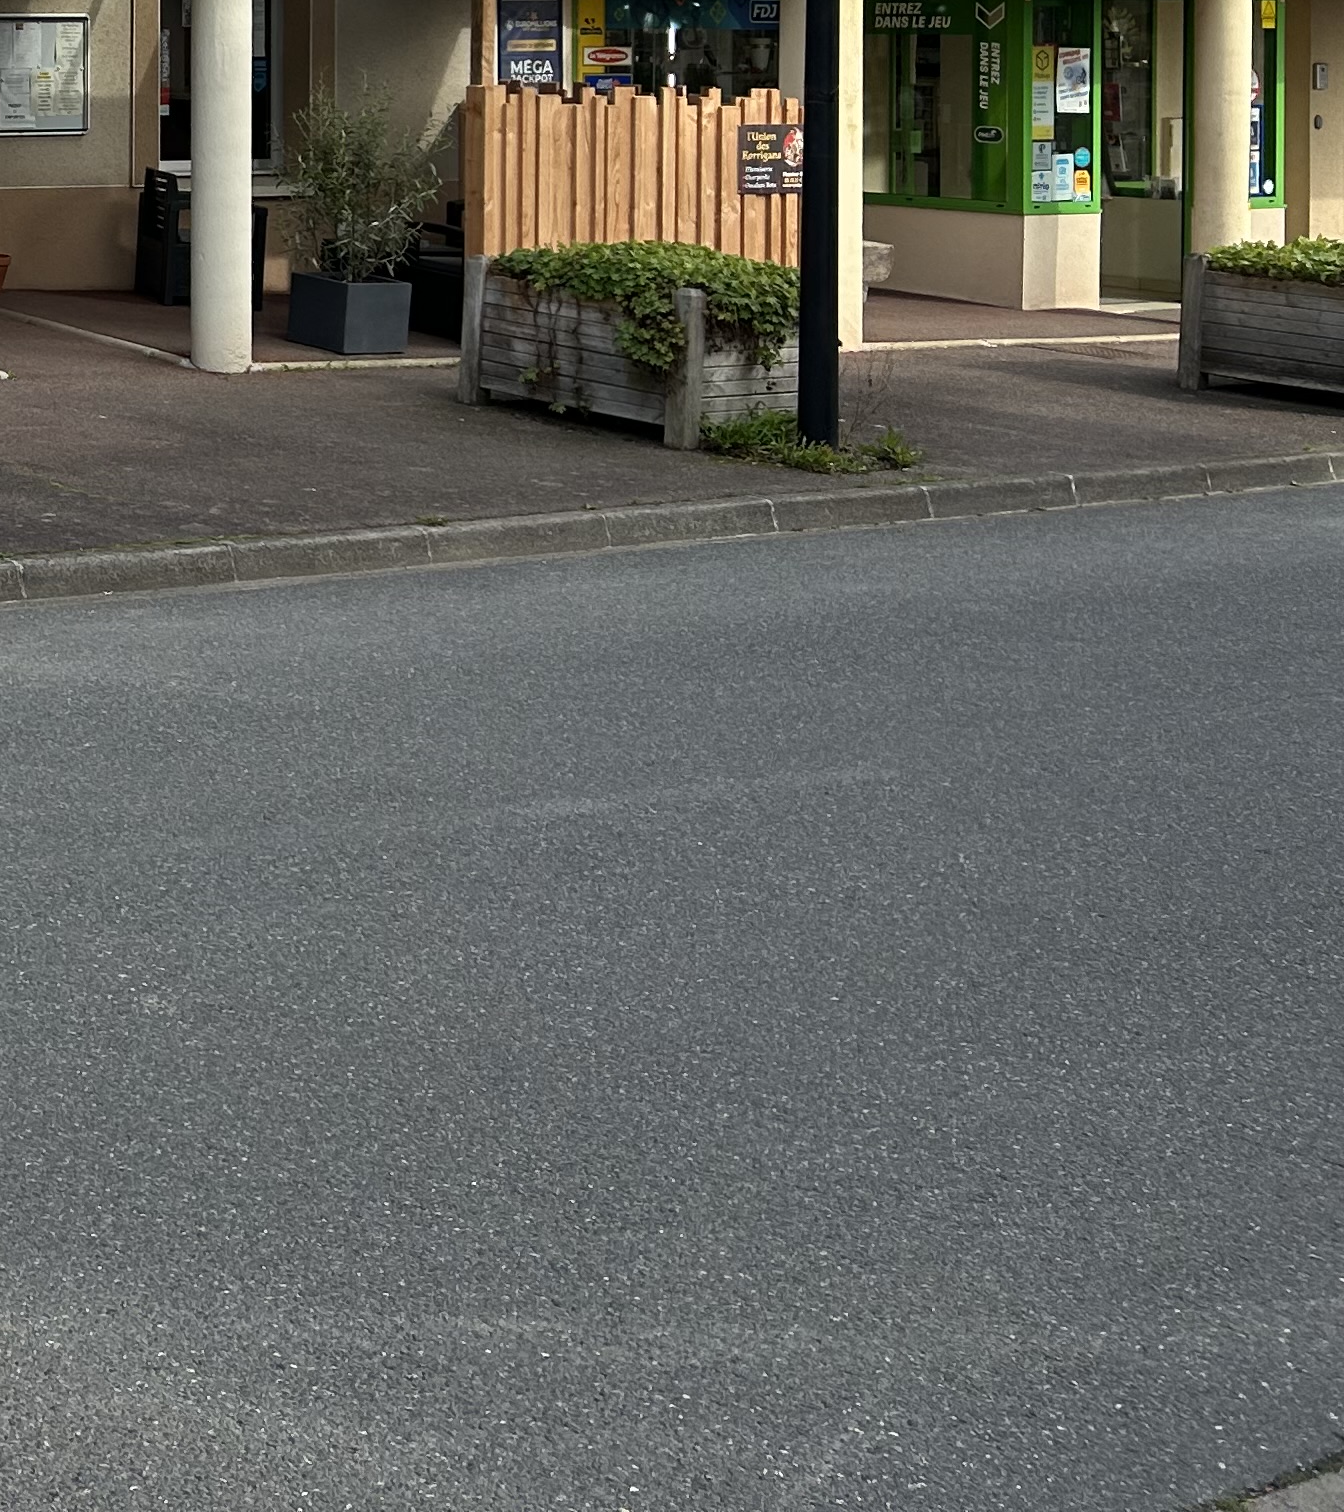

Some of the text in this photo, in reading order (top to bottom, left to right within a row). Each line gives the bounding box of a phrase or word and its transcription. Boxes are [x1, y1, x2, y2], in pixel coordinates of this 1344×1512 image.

[752, 3, 778, 19] FDJ
[874, 2, 923, 15] ENTREZ
[874, 16, 952, 29] DANS LE JEU
[990, 42, 1001, 86] ENTREZ
[979, 41, 989, 110] DANS LE JEU
